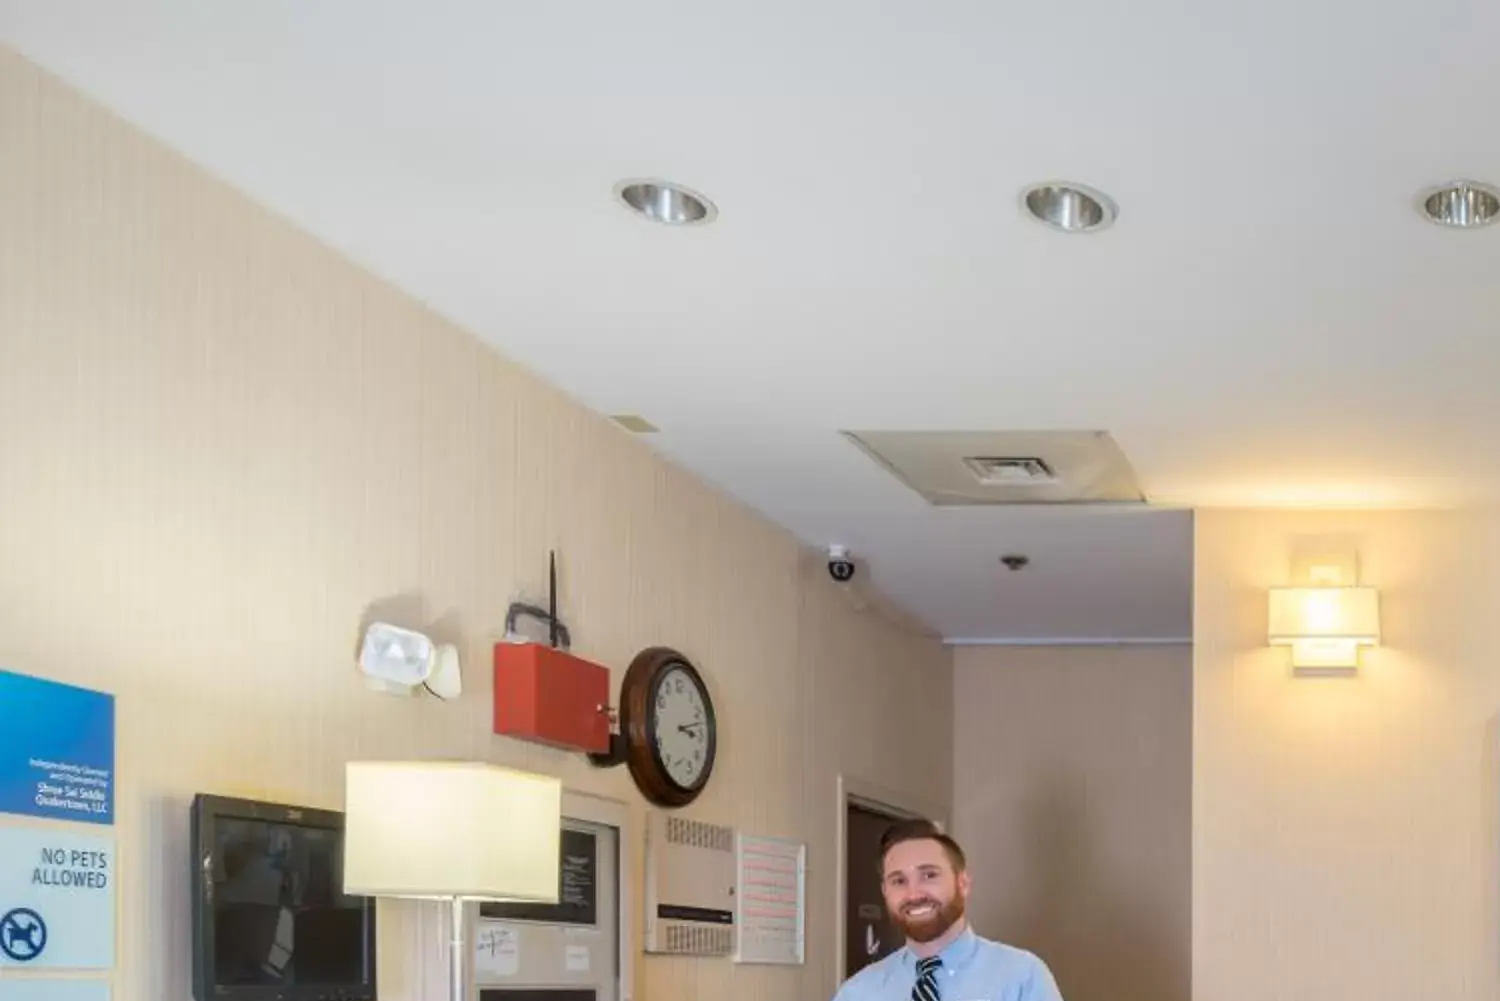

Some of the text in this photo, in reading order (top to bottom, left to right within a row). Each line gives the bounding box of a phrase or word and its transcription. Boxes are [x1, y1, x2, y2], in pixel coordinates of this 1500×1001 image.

[42, 847, 107, 869] NO PETS
[32, 868, 107, 889] ALLOWED
